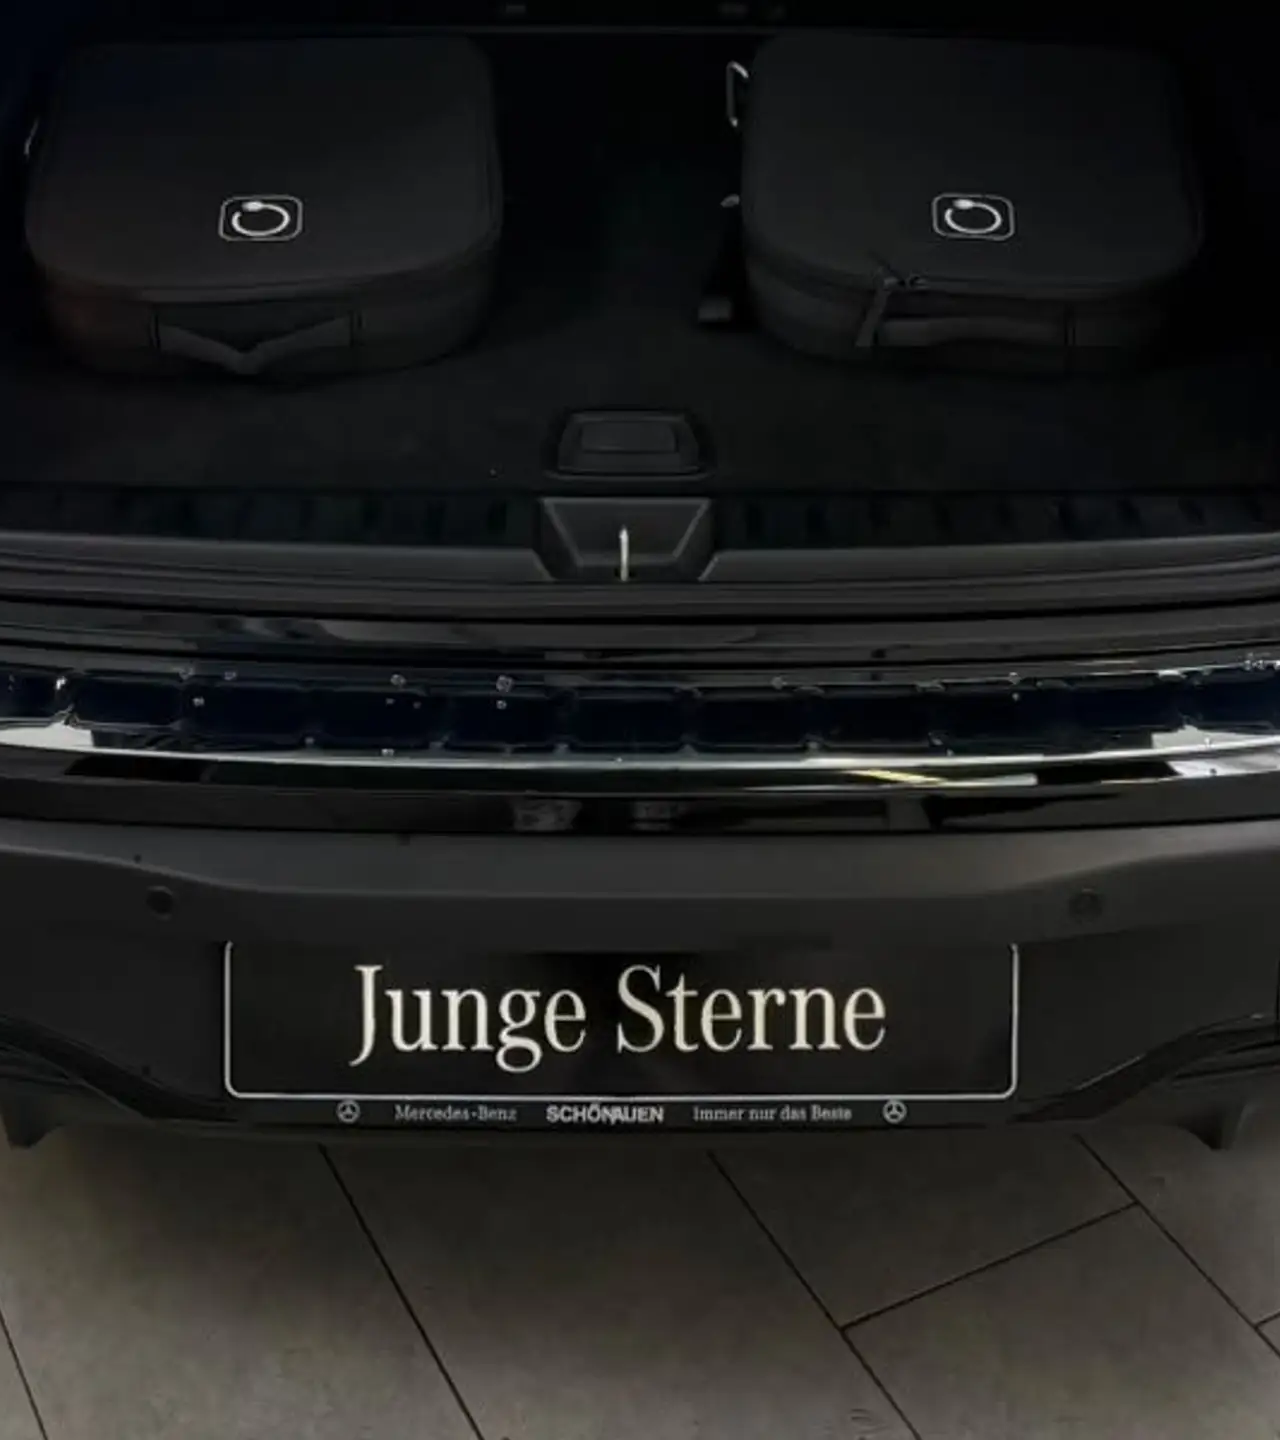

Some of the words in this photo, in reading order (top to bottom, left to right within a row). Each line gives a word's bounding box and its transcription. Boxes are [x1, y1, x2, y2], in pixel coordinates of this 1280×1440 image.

[349, 962, 588, 1074] Junge
[615, 963, 888, 1056] Sterne
[395, 1103, 518, 1123] Mercedes-Benz
[780, 1104, 807, 1123] das
